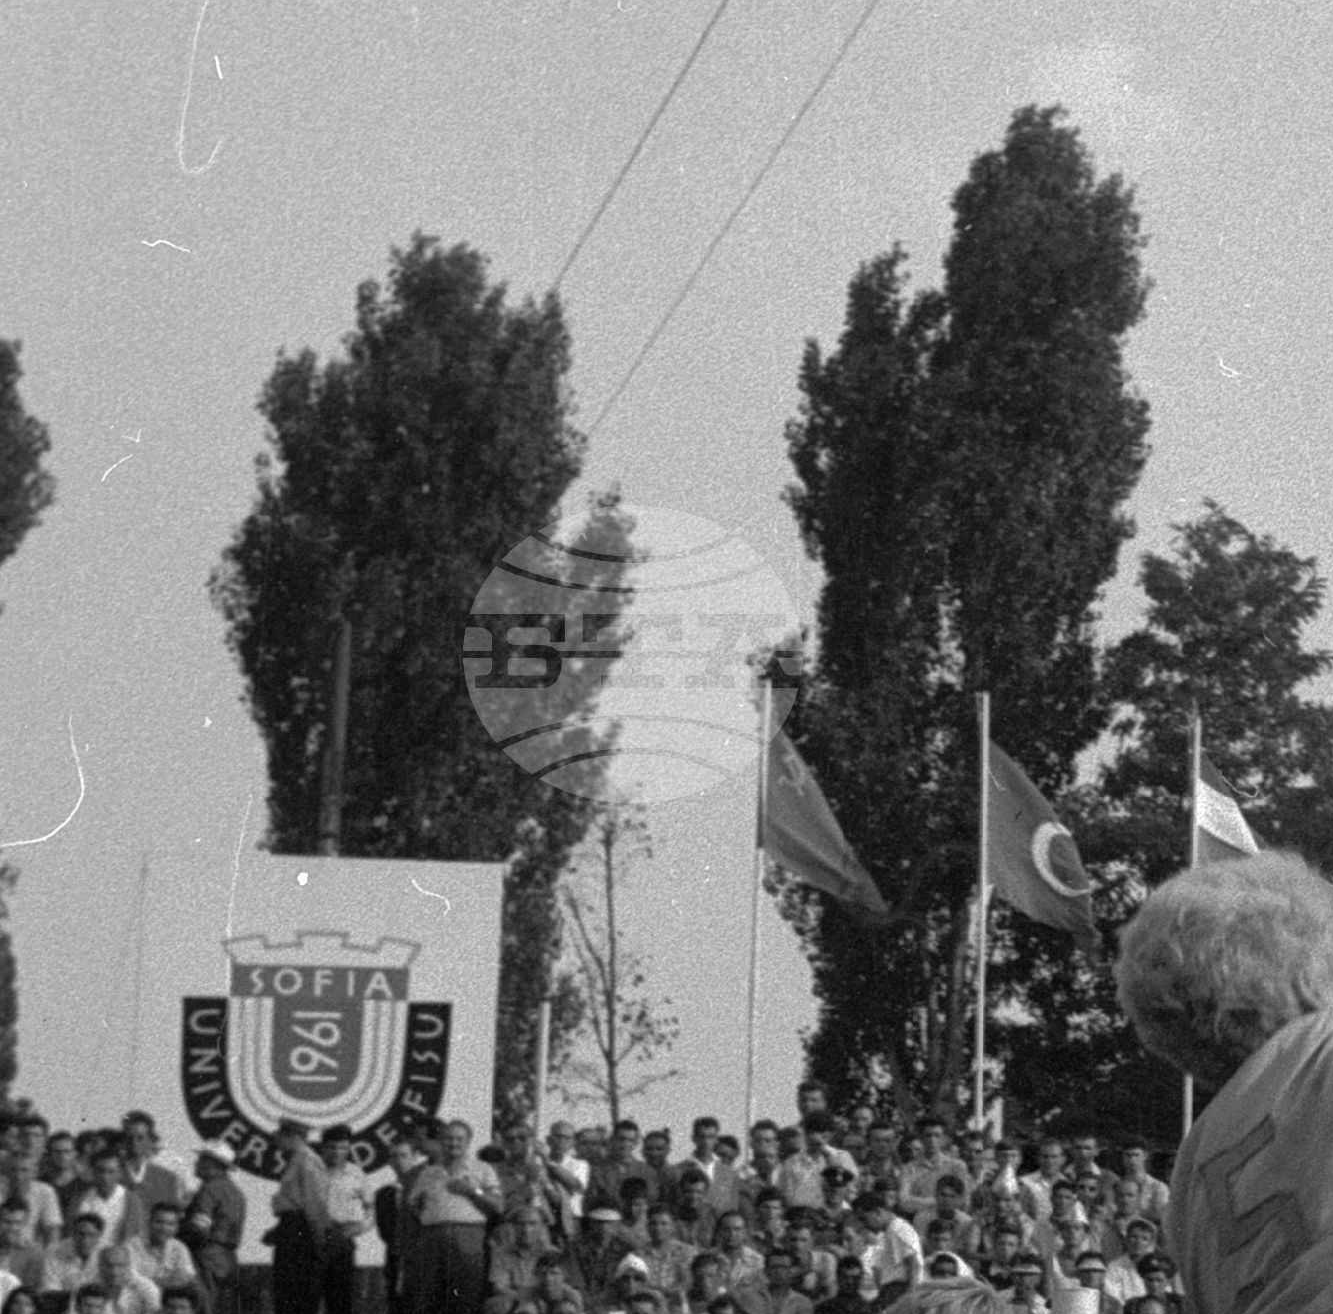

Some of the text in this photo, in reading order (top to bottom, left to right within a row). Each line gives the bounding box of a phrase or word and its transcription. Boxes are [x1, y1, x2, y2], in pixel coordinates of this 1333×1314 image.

[250, 969, 394, 997] SOFIA
[290, 1011, 342, 1082] 1961
[189, 1008, 445, 1174] UNIVERSDE FISU
